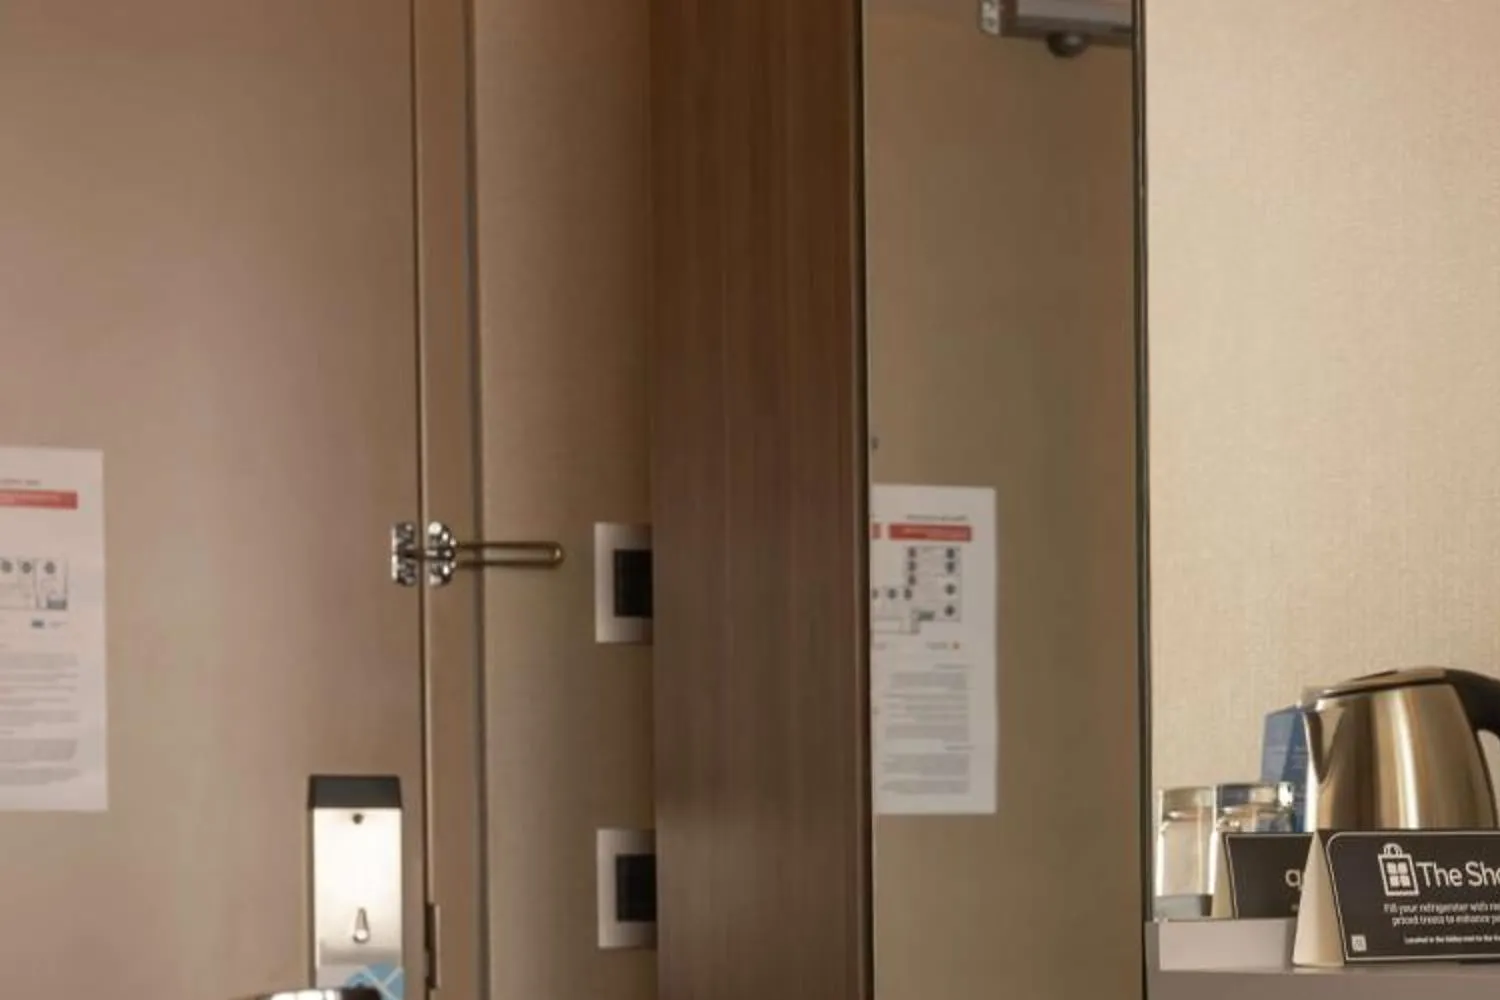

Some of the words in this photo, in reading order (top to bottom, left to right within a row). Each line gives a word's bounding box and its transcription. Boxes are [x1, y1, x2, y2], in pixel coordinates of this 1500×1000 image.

[1415, 861, 1463, 888] The
[1383, 902, 1397, 913] Fill
[1399, 904, 1418, 916] your
[1470, 900, 1488, 912] with
